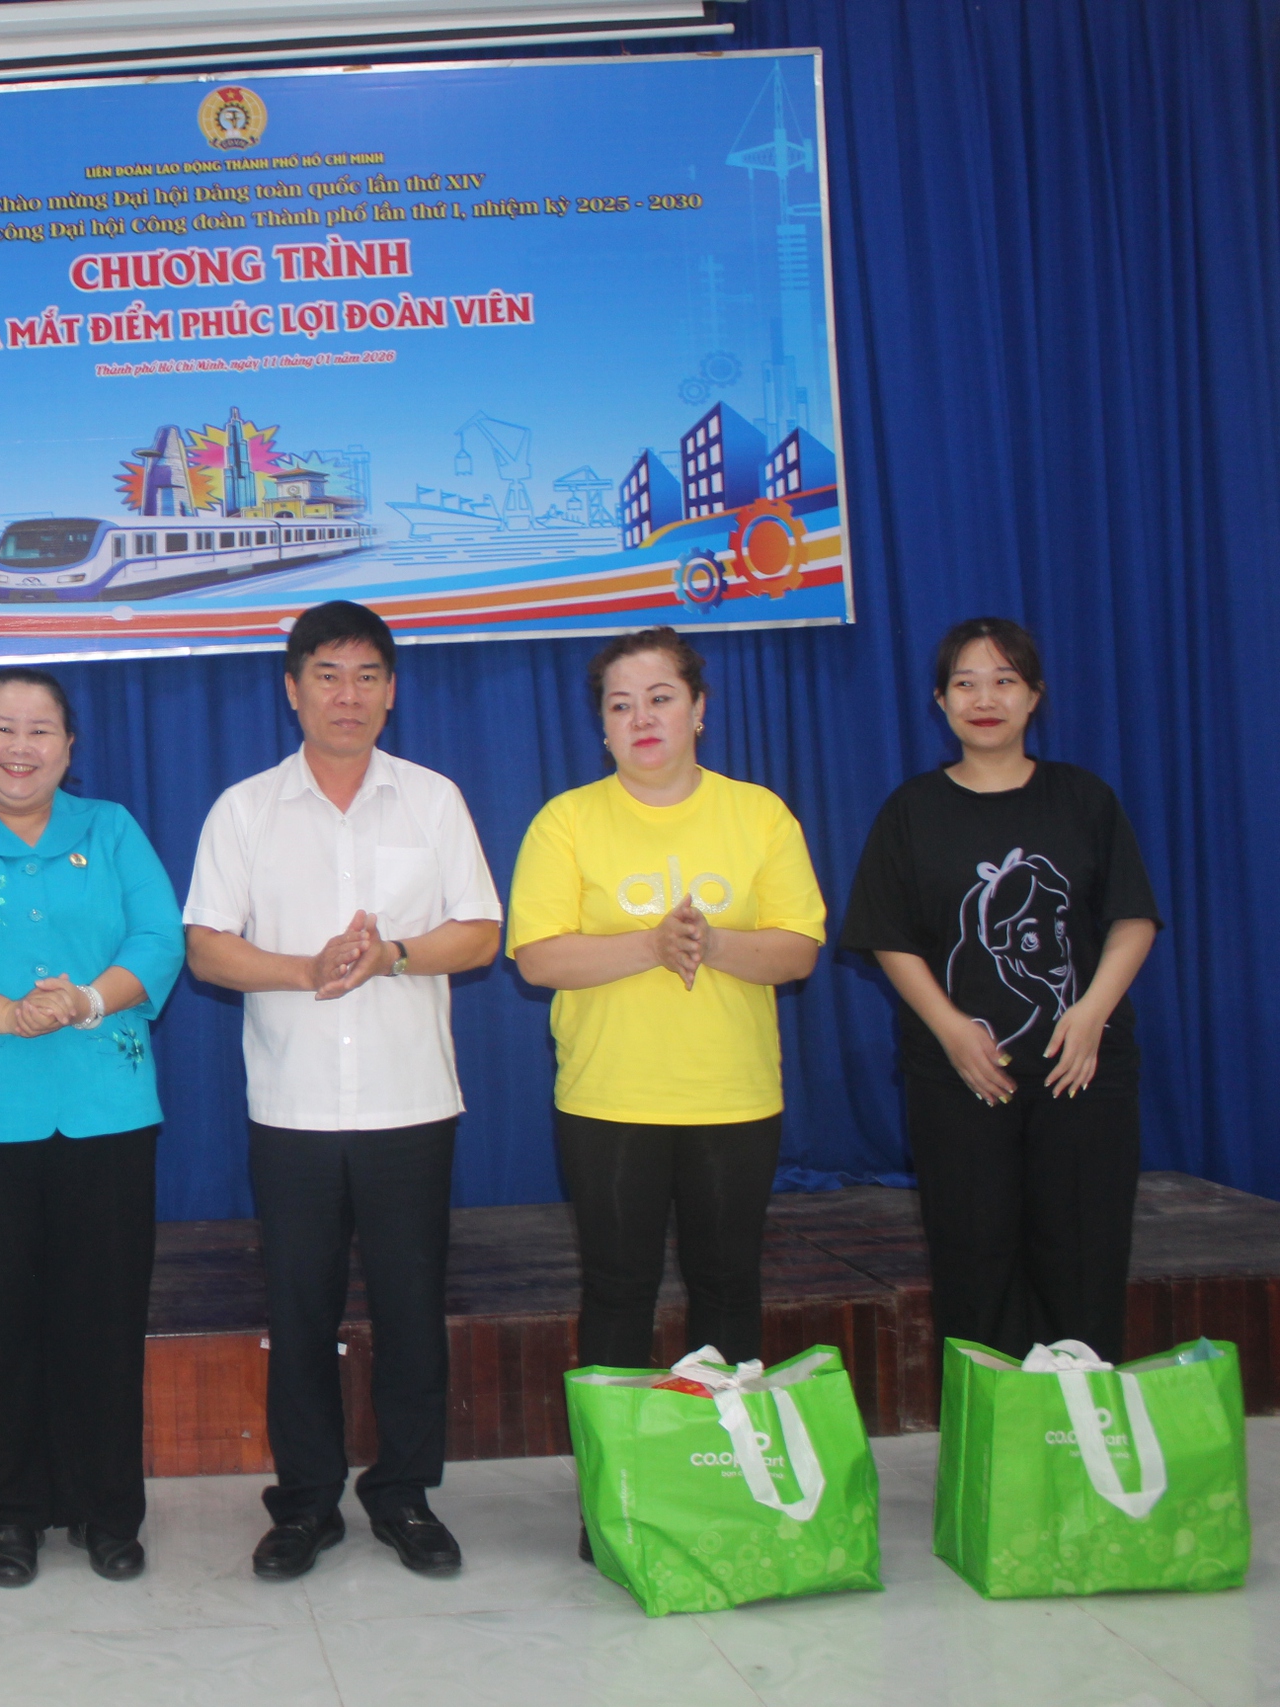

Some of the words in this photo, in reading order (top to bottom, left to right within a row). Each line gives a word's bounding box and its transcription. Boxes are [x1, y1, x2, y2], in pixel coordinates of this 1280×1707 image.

[85, 164, 112, 179] LIÊN
[115, 162, 152, 177] ĐOÀN
[155, 162, 180, 175] LAO
[184, 159, 222, 175] ĐỘNG
[225, 157, 269, 171] THÀNH
[272, 153, 299, 168] PHỐ
[302, 152, 321, 167] HỒ
[325, 152, 348, 166] CHÍ
[350, 153, 385, 165] MINH
[47, 191, 108, 210] mừng
[113, 188, 148, 209] Đại
[154, 187, 188, 208] hội
[194, 183, 251, 203] Đảng
[255, 180, 302, 199] toàn
[308, 174, 362, 199] quốc
[367, 173, 400, 193] lần
[406, 172, 442, 192] thứ
[445, 173, 486, 190] XIV
[50, 220, 85, 241] Đại
[91, 217, 125, 239] hội
[131, 215, 188, 235] Công
[192, 210, 246, 230] đoàn
[252, 207, 320, 227] Thành
[326, 201, 368, 226] phố
[373, 201, 406, 221] lần
[411, 201, 447, 220] thứ
[452, 202, 467, 220] I,
[472, 197, 540, 220] nhiệm
[544, 195, 572, 217] kỳ
[576, 196, 631, 214] 2025
[649, 192, 704, 211] 2030
[71, 246, 264, 291] CHƯƠNG
[274, 234, 412, 281] TRÌNH
[6, 305, 83, 348] MẮT
[88, 300, 172, 345] ĐIỂM
[180, 299, 273, 339] PHÚC
[279, 300, 337, 339] LỢI
[344, 291, 448, 332] ĐOÀN
[451, 288, 534, 327] VIÊN
[95, 363, 132, 377] Thành
[134, 360, 157, 377] phố
[175, 358, 194, 373] Chí
[229, 356, 259, 372] ngày
[280, 352, 313, 368] tháng
[315, 352, 331, 366] 01
[334, 352, 360, 365] năm
[362, 350, 396, 363] 2026
[617, 855, 733, 916] alo
